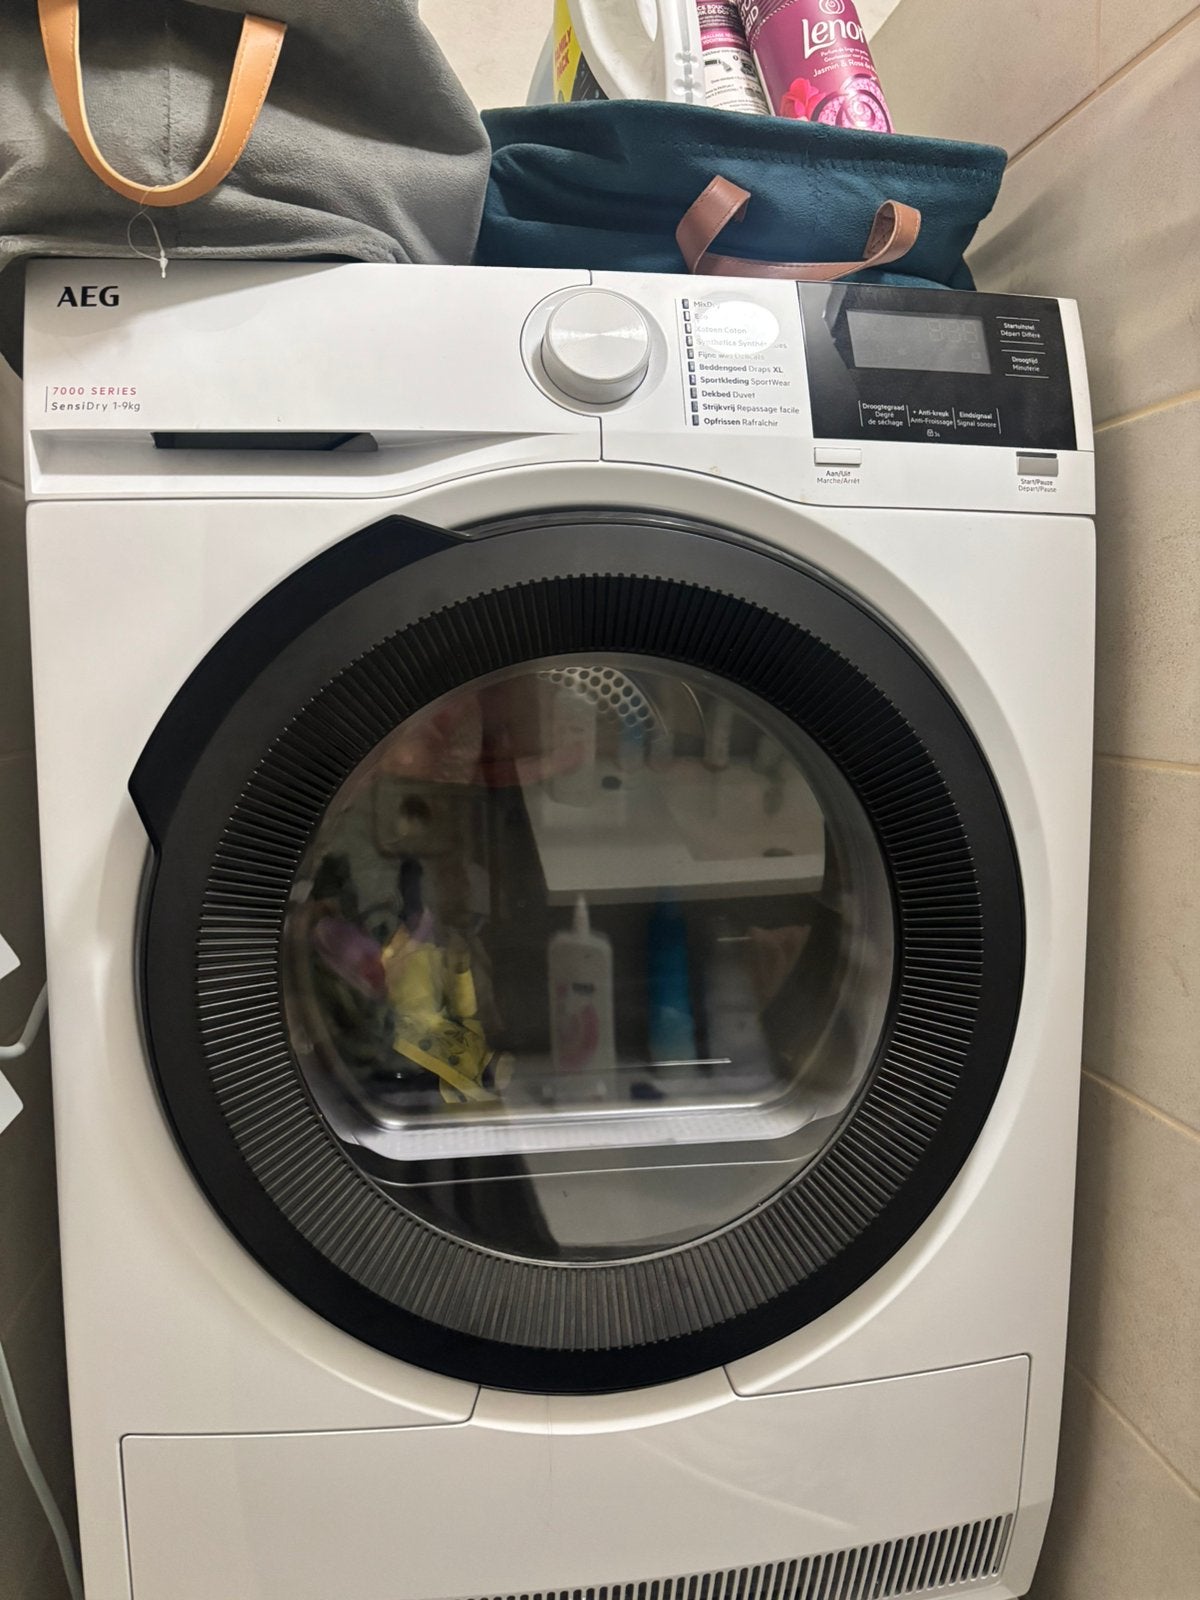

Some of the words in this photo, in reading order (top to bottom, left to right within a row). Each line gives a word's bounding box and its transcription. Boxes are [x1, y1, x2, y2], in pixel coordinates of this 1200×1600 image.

[801, 18, 864, 59] Lenor
[813, 62, 839, 77] Jasmin
[57, 286, 119, 307] AEG
[699, 363, 747, 373] Beddengoed
[748, 365, 771, 373] Draps
[700, 376, 749, 386] Sportkleding
[751, 378, 790, 387] SportWear
[53, 387, 85, 395] 7000
[91, 387, 137, 395] SERIES
[701, 390, 731, 398] Dekbed
[733, 391, 755, 399] Duvet
[52, 402, 108, 411] SensiDry
[113, 402, 140, 412] 1-9kg
[702, 403, 735, 412] Strijkvrij
[737, 405, 778, 414] Repassage
[780, 406, 800, 414] facile
[862, 403, 904, 411] Droogtegraad
[918, 409, 949, 417] Anti-kreuk
[959, 411, 992, 420] Eindsignaal
[704, 417, 741, 426] Opfrissen
[878, 419, 903, 427] séchage
[911, 417, 953, 426] Anti-Froissage
[957, 419, 975, 427] Signal
